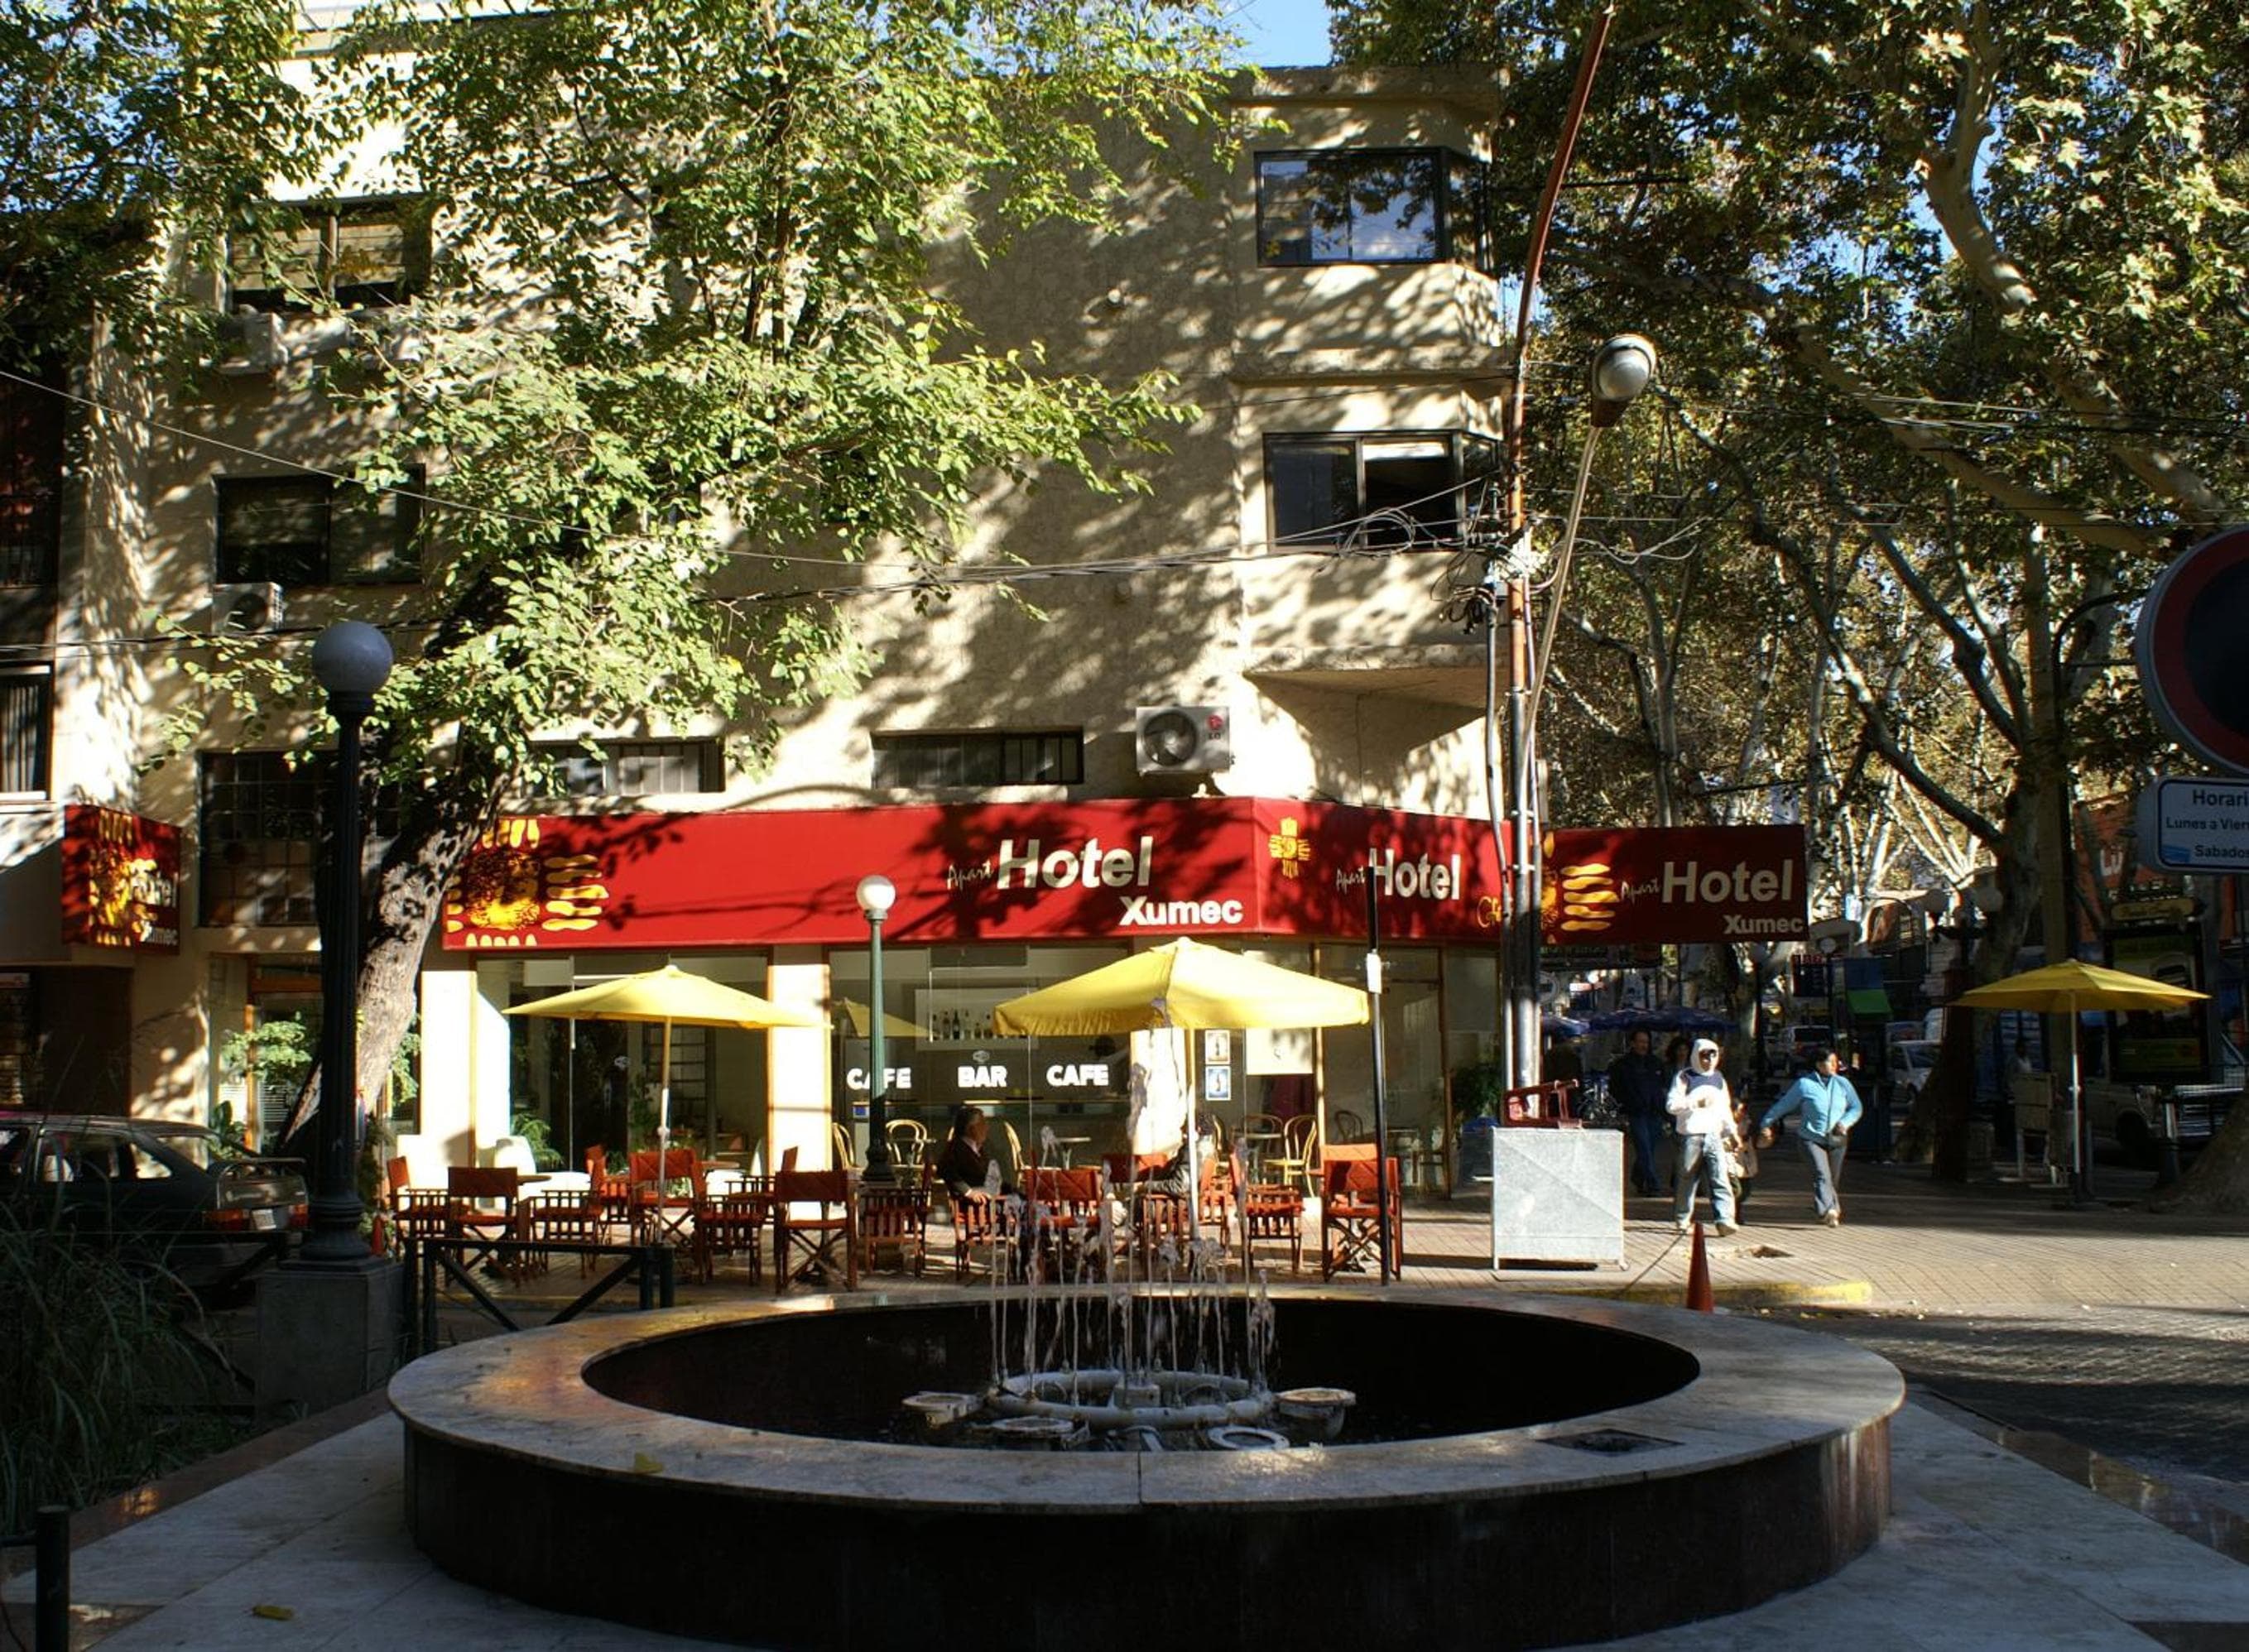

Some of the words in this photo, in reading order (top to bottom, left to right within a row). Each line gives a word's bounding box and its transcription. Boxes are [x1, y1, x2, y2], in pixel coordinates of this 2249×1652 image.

[2165, 817, 2207, 829] Lunes
[2209, 820, 2217, 829] a
[947, 860, 993, 891] Apart
[997, 836, 1153, 890] Hotel
[1335, 866, 1366, 895] Apart
[1368, 848, 1461, 900] Hotel
[1621, 876, 1660, 906] Apart
[1661, 859, 1793, 904] Hotel
[1119, 896, 1243, 926] Xumec
[1723, 914, 1804, 934] Xumec
[957, 1065, 1007, 1088] BAR
[1045, 1064, 1109, 1087] CAFE
